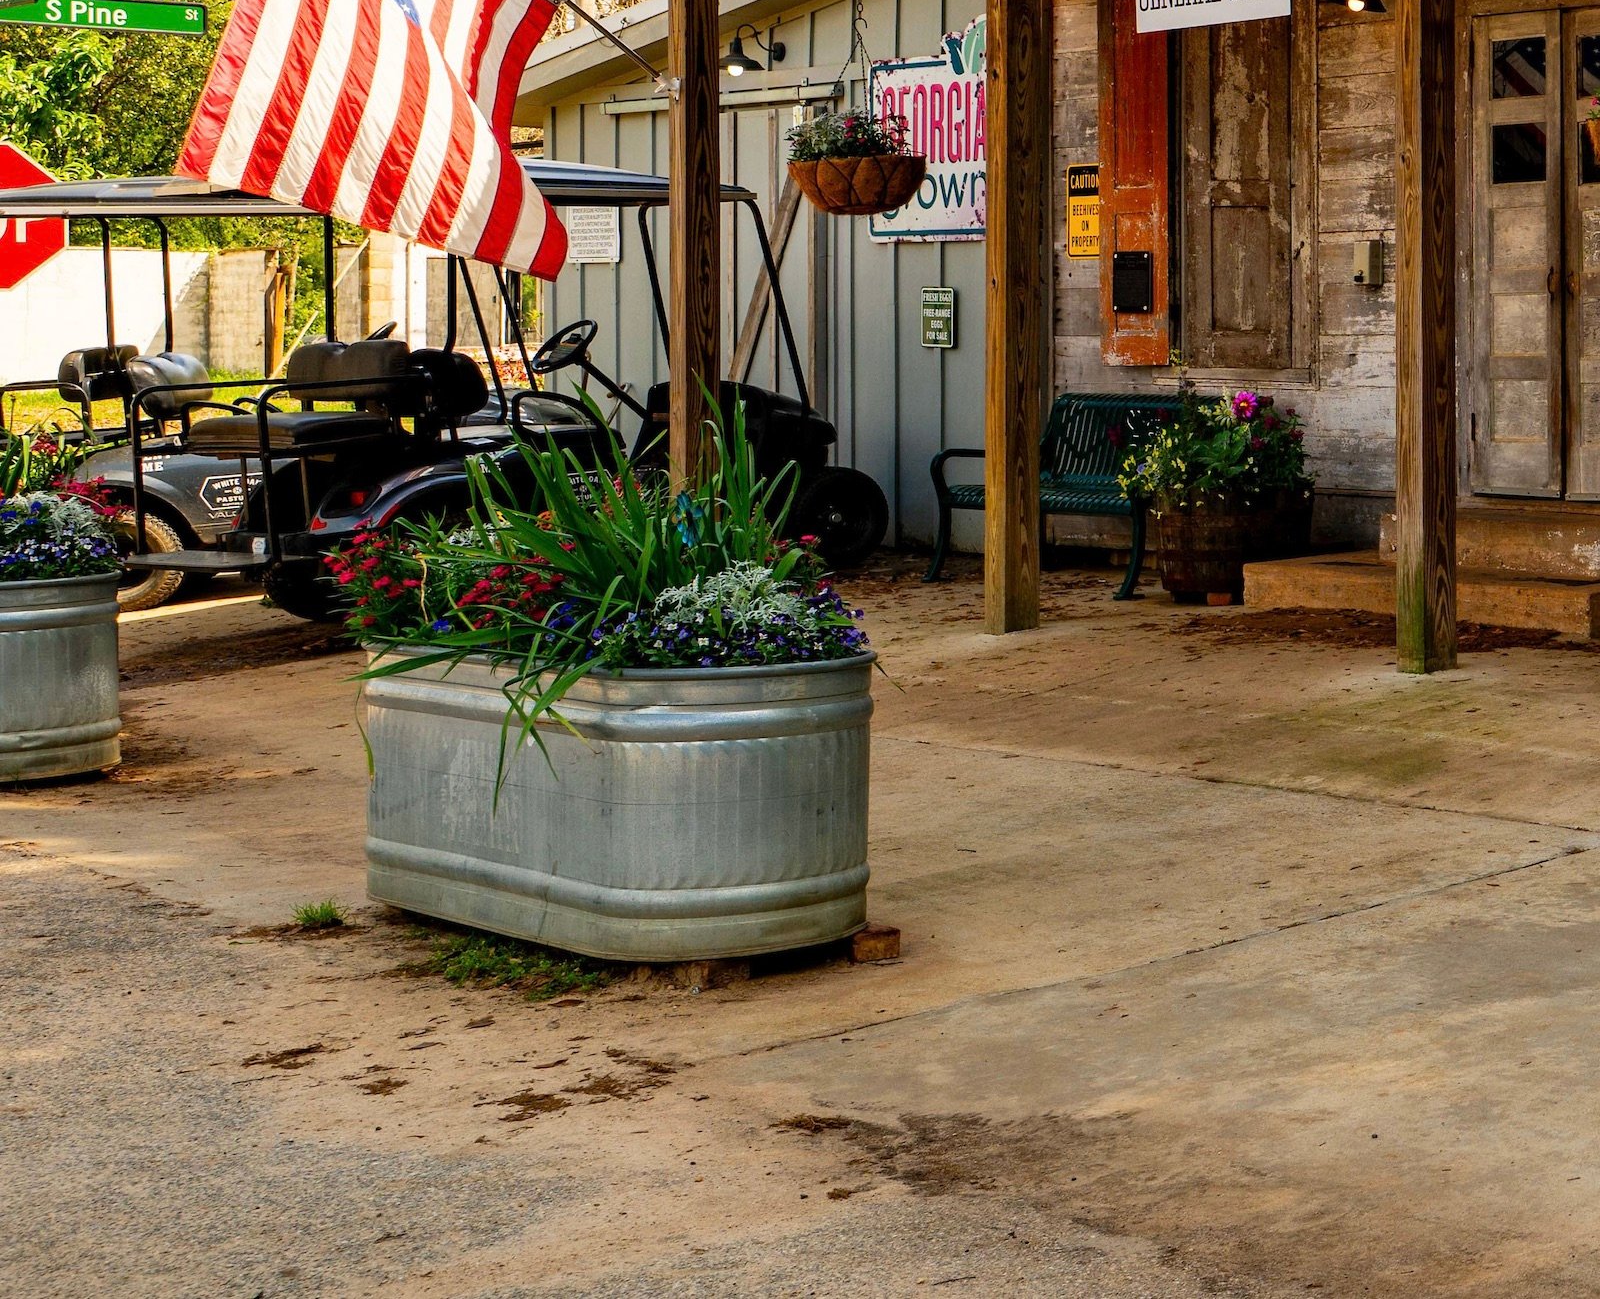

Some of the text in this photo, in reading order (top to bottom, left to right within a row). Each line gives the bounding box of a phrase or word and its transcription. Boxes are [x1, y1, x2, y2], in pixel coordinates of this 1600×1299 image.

[45, 0, 198, 26] S Pine St
[1070, 174, 1099, 189] CAUTION
[1073, 204, 1100, 216] BEEHIVES
[1082, 220, 1089, 231] ON
[1072, 236, 1100, 247] PROPERTY
[939, 293, 951, 301] EGGS
[931, 320, 943, 328] EGGS
[926, 331, 947, 340] FOR SALE
[212, 478, 240, 490] WHITE
[216, 495, 244, 503] PASTU
